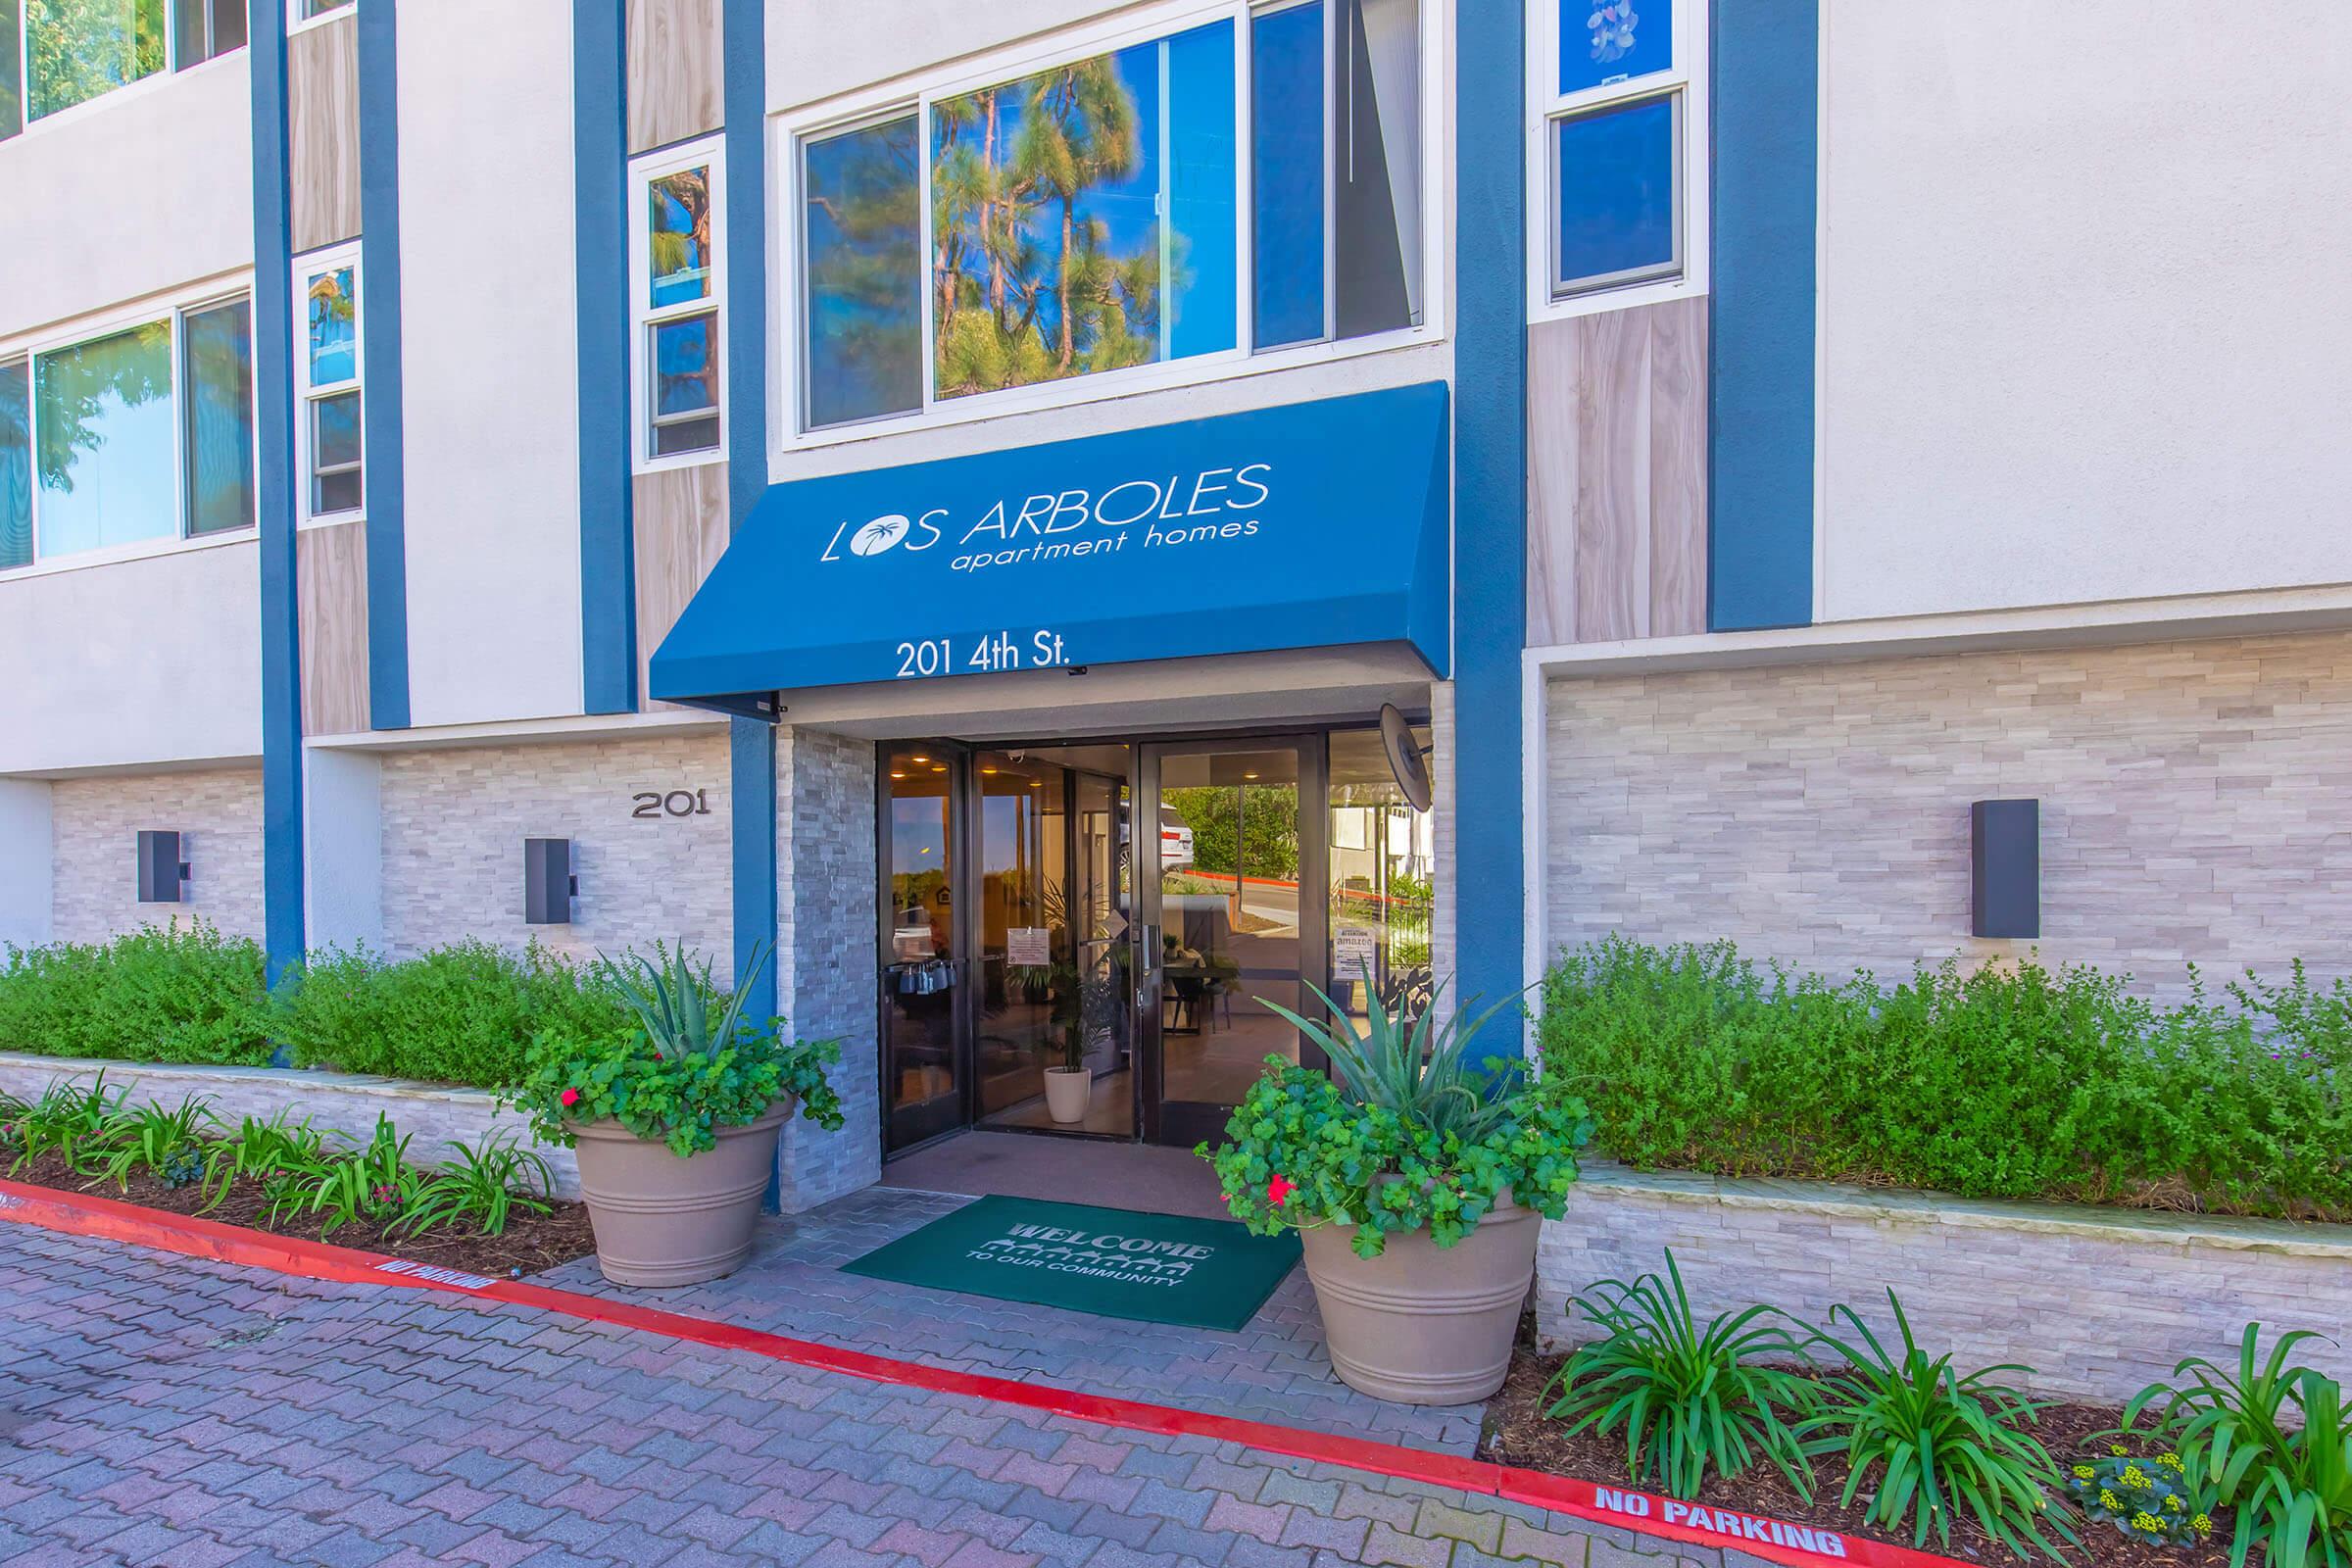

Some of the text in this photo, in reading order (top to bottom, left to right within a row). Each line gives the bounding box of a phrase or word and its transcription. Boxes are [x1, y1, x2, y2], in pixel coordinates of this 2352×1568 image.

[821, 464, 1272, 562] LOS ARBOLES
[951, 519, 1259, 573] apartment homes
[896, 630, 1070, 677] 201 4th St.
[632, 788, 711, 817] 201
[1005, 1223, 1215, 1260] WELCOME
[374, 1260, 498, 1289] NO PARKING
[965, 1250, 1183, 1287] TO OUR COMMUNITY
[1595, 1488, 1846, 1557] NO PARKING
